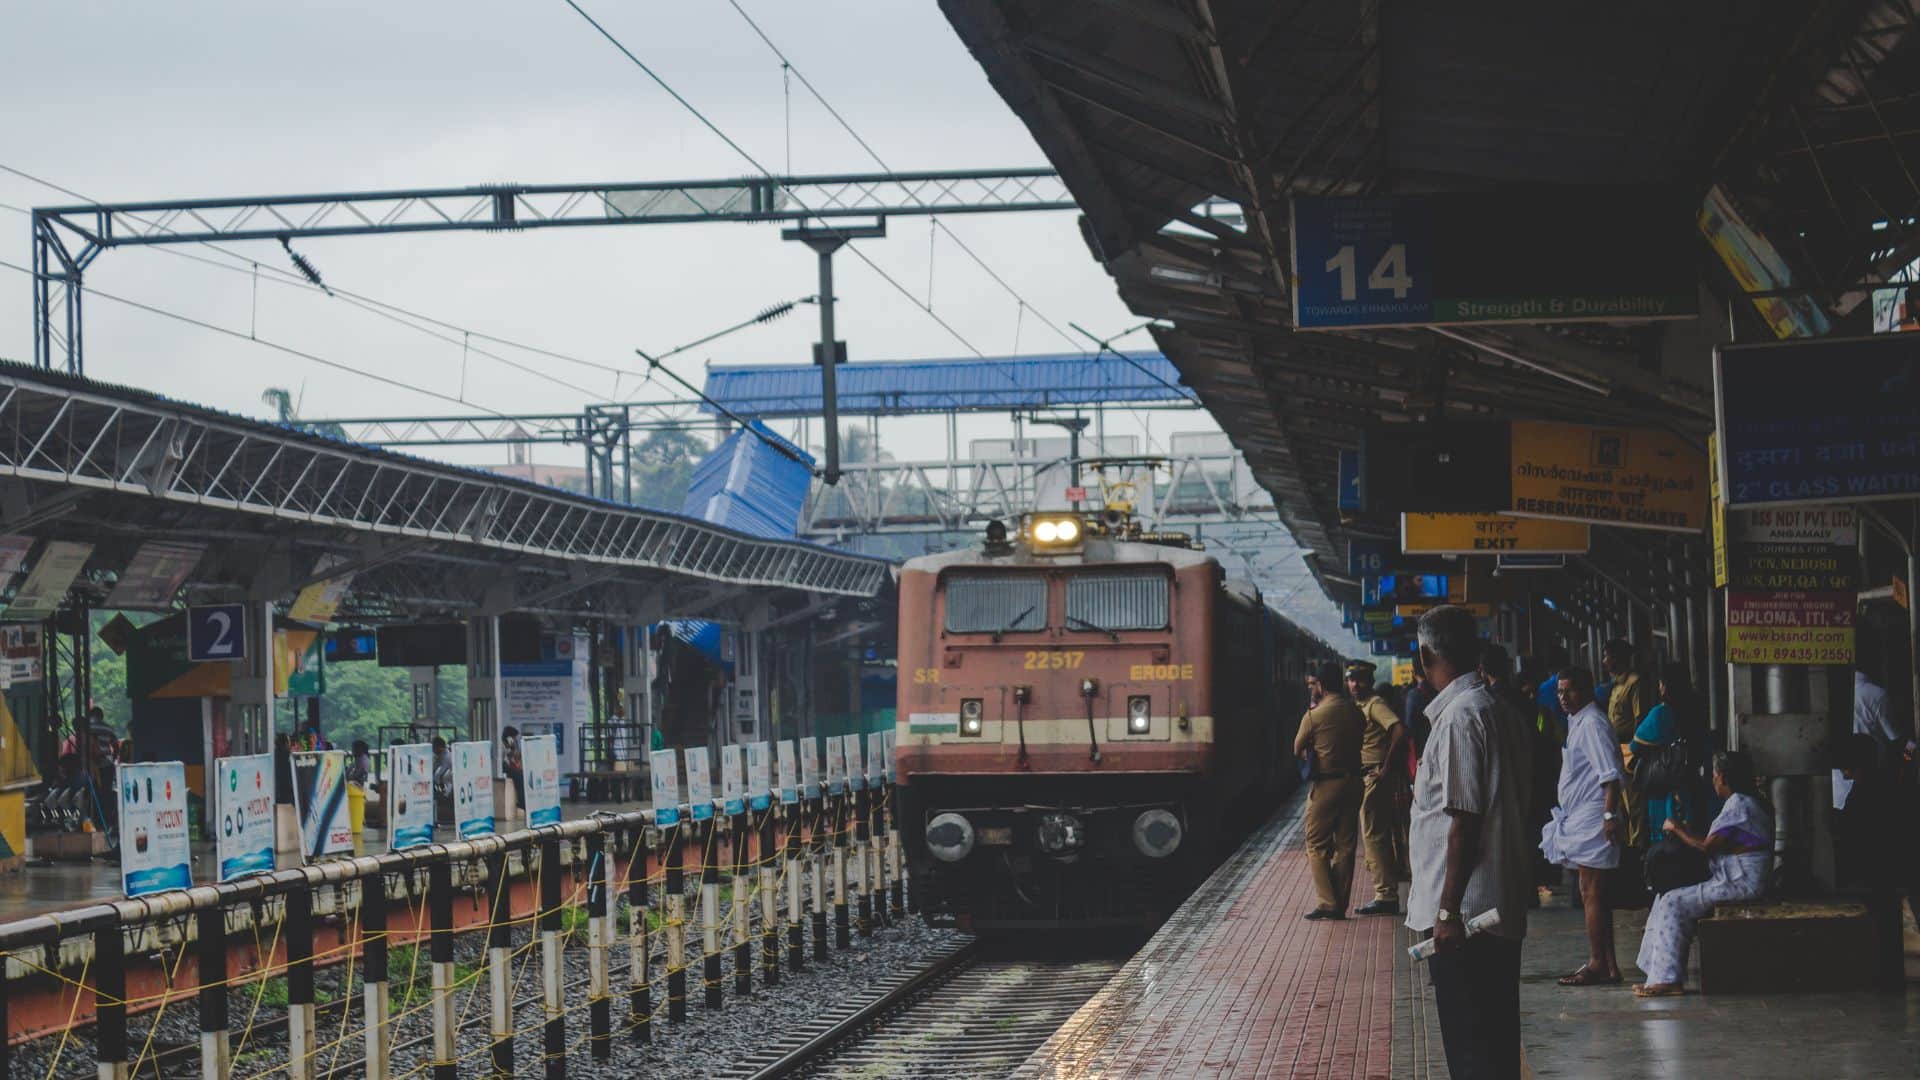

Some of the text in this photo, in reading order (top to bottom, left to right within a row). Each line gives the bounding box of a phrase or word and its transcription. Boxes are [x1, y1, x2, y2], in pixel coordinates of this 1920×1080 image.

[1325, 244, 1414, 301] 14
[1457, 295, 1666, 318] Strength & Durability
[1767, 477, 1841, 498] CLASS
[1516, 496, 1622, 520] RESERVATION
[1776, 511, 1801, 529] NDT
[1830, 511, 1856, 529] LTD.
[1473, 537, 1519, 550] EXIT
[1730, 609, 1802, 627] DIPLOMA,
[1831, 610, 1852, 626] +2
[206, 610, 234, 655] 2
[1737, 629, 1846, 643] www.bssndt.com
[1023, 650, 1086, 671] 22517
[914, 664, 1194, 684] SR ERODE
